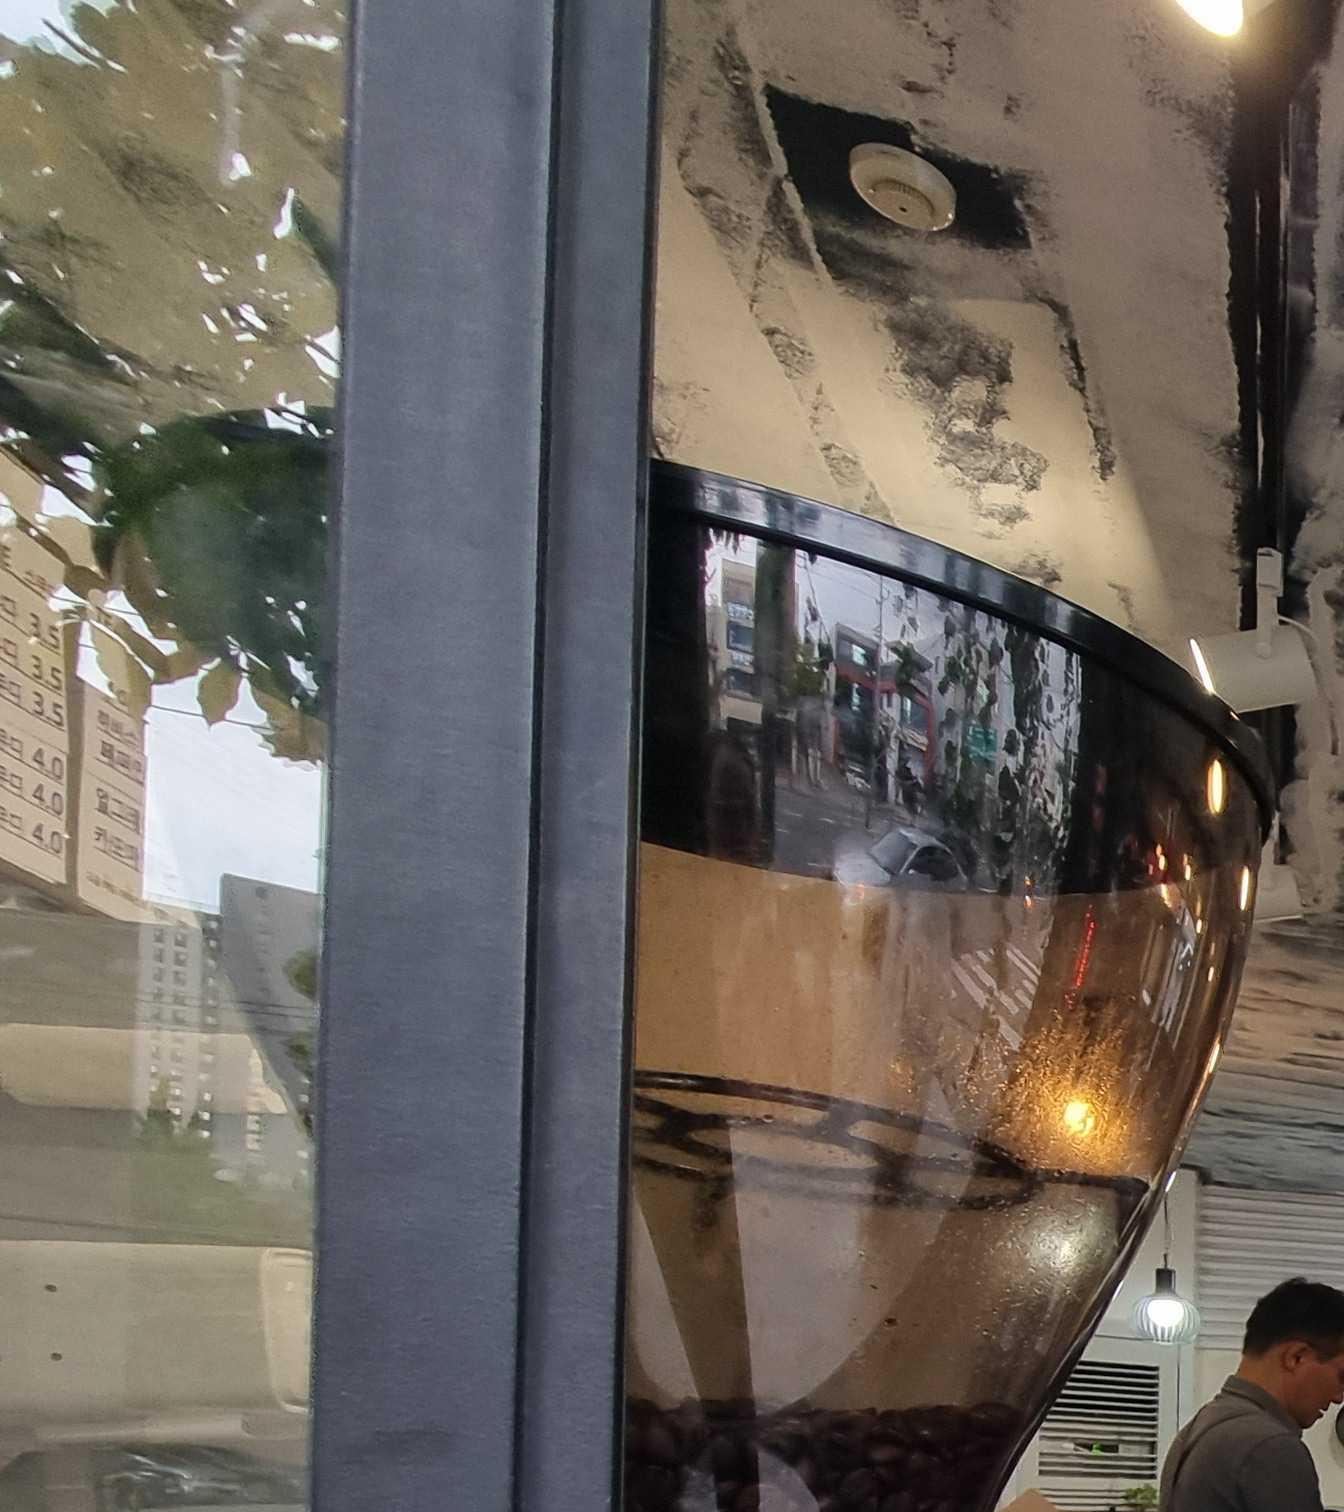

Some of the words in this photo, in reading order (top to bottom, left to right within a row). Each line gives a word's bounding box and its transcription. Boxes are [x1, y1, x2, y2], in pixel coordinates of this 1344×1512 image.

[29, 612, 60, 650] 3.5
[31, 655, 62, 691] 3.5
[33, 691, 64, 727] 3.5
[32, 747, 64, 780] 4.0
[32, 783, 64, 816] 4.0
[32, 822, 64, 855] 4.0
